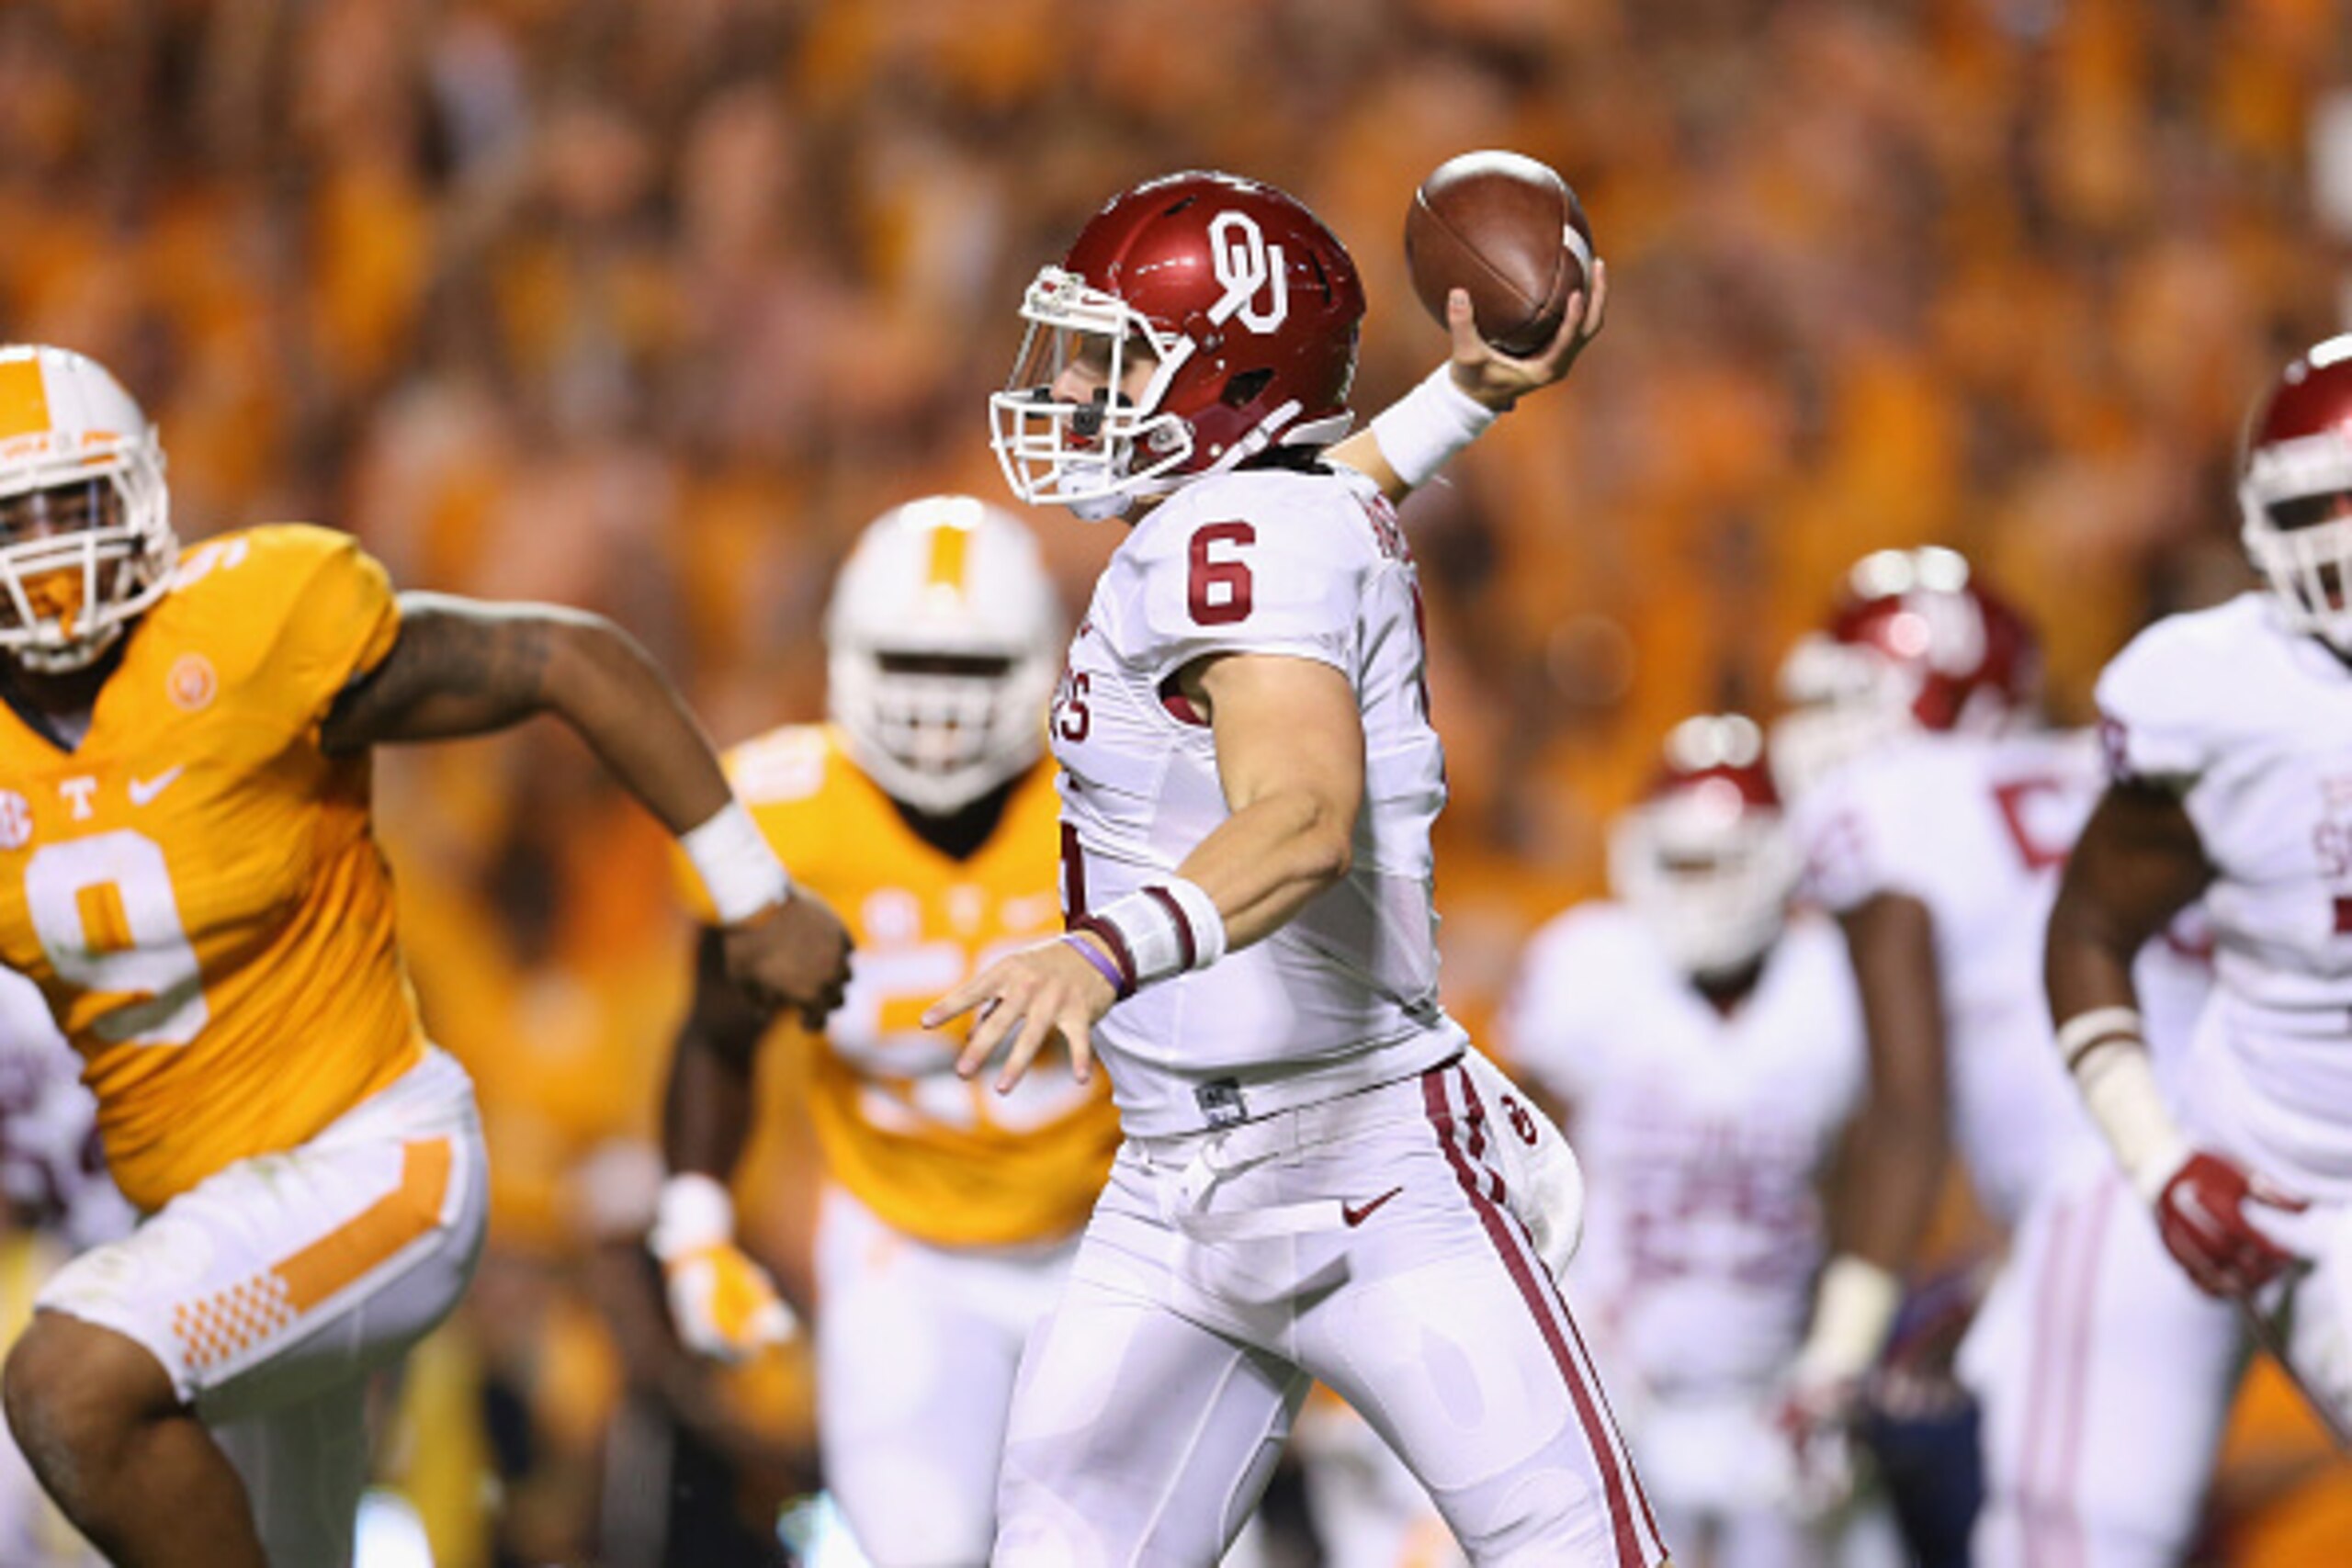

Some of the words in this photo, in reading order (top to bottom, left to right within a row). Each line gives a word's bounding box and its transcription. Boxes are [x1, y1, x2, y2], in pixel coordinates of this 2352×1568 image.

[1207, 209, 1289, 334] OU
[1188, 520, 1256, 626] 6
[59, 775, 96, 820] T
[24, 827, 210, 1047] 9
